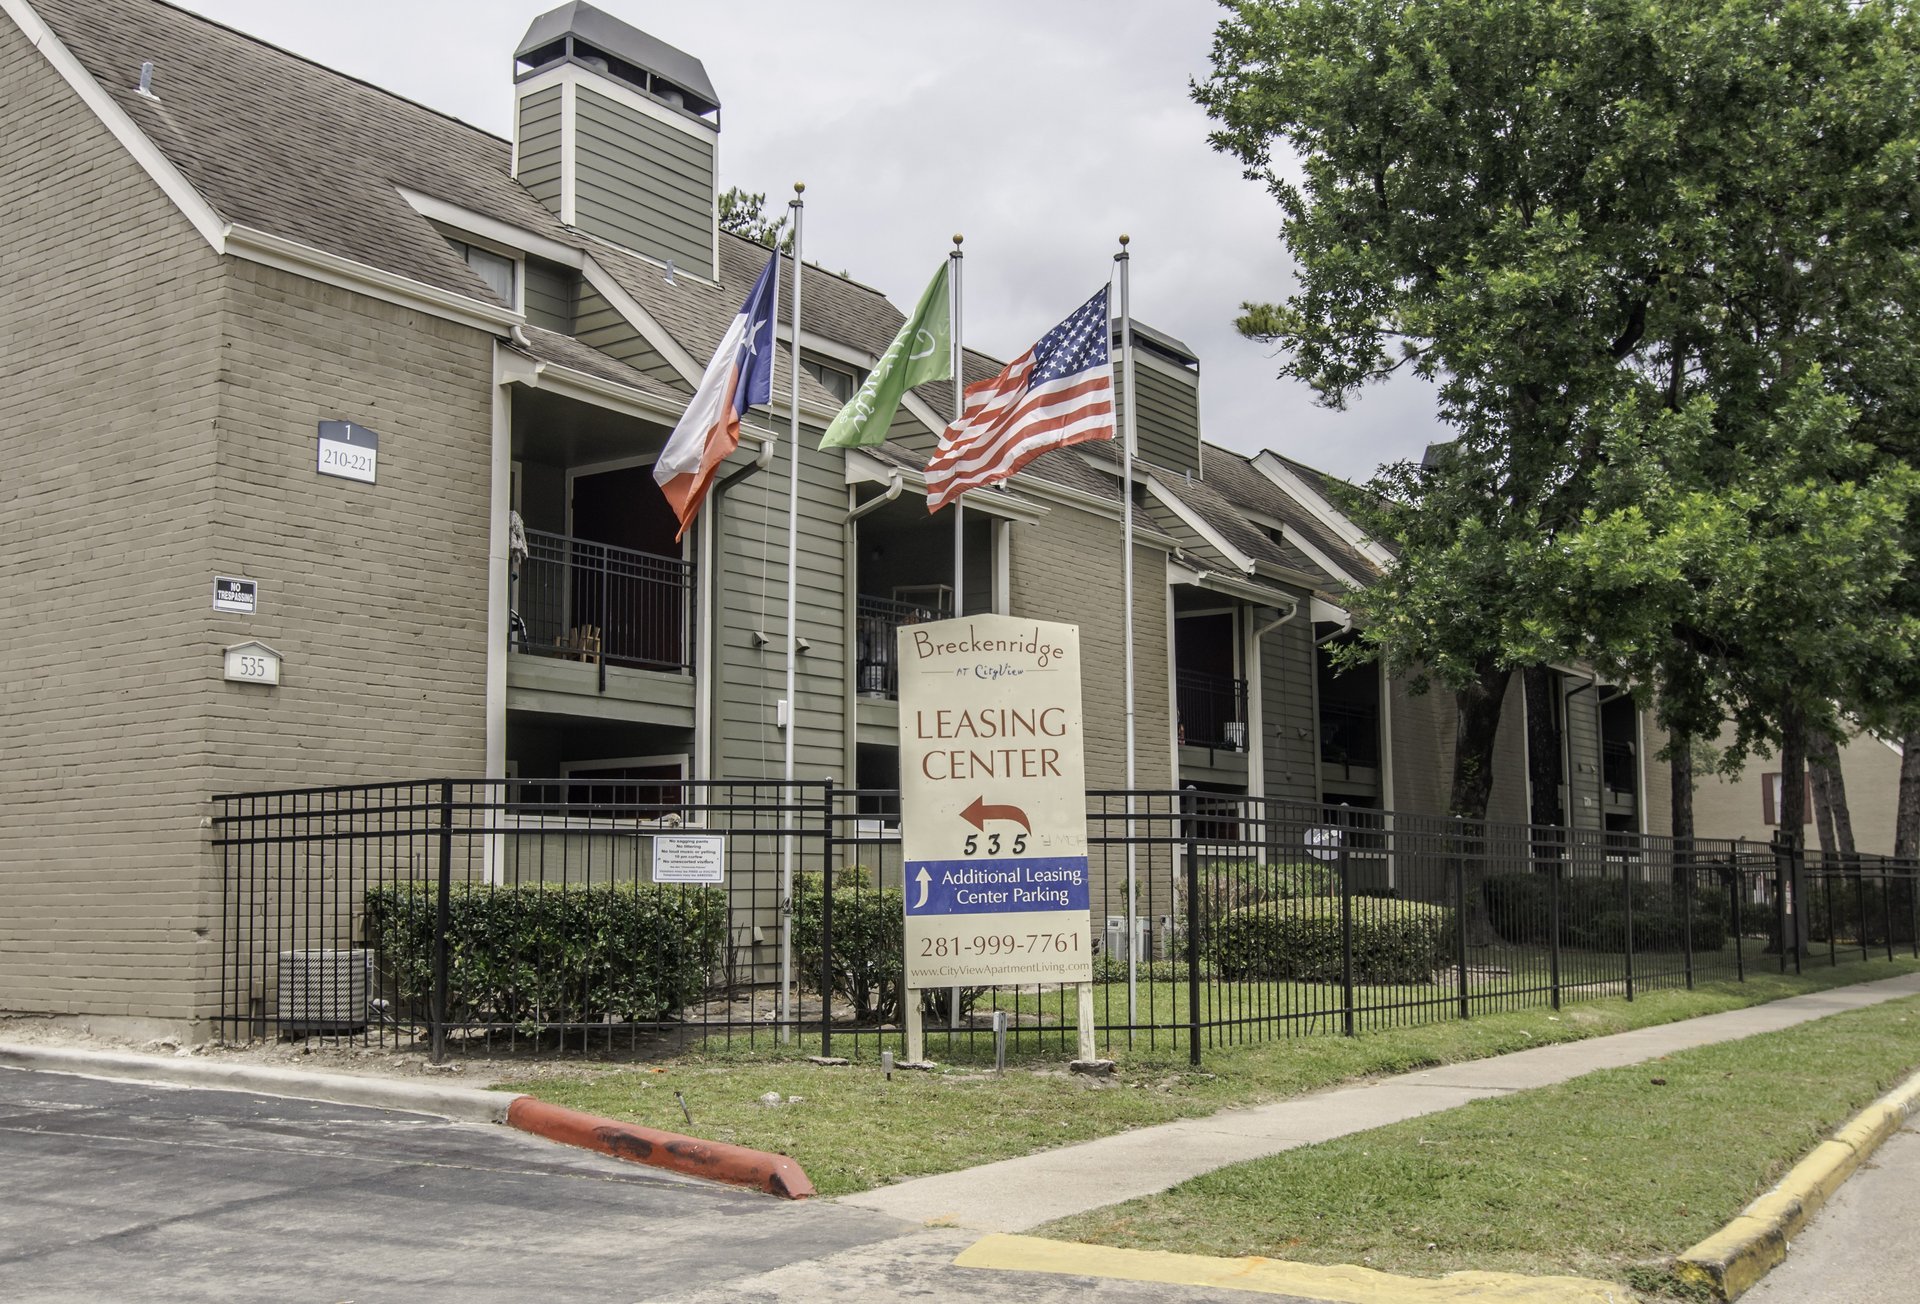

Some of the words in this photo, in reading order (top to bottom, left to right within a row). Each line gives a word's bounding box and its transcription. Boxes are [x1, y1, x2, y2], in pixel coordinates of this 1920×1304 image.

[345, 424, 351, 440] 1
[323, 448, 372, 472] 210-221
[217, 590, 253, 603] TRESPASSING
[230, 582, 241, 592] NO
[913, 624, 1064, 667] Breckenridge
[240, 656, 265, 677] 535
[917, 707, 1066, 739] LEASING
[922, 748, 1062, 780] CENTER
[963, 833, 1028, 856] 535
[942, 867, 1021, 885] Additional
[1026, 867, 1082, 886] Leasing
[956, 889, 1009, 905] Center
[1013, 886, 1069, 906] Parking
[920, 932, 1079, 957] 281-999-7761
[911, 961, 1090, 977] www.CityViewApartmentLiving.com
